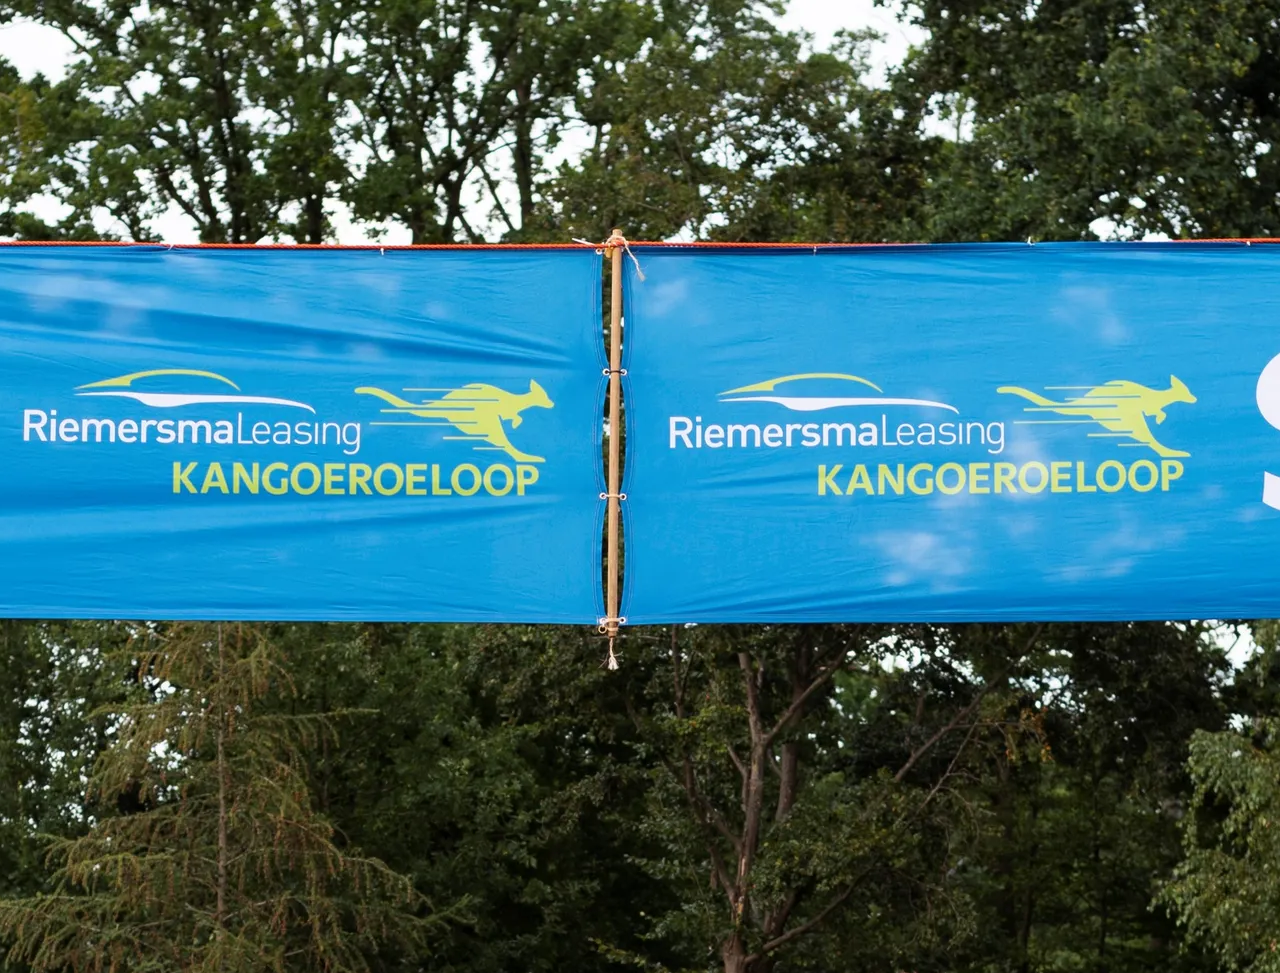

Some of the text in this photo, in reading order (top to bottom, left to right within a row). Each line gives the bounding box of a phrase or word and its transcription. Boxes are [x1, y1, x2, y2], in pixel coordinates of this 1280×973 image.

[23, 408, 361, 455] RiemersmaLeasing
[669, 411, 1005, 455] RiemersmaLeasing
[172, 461, 540, 497] KANGOEROELOOP
[817, 459, 1184, 497] KANGOEROELOOP
